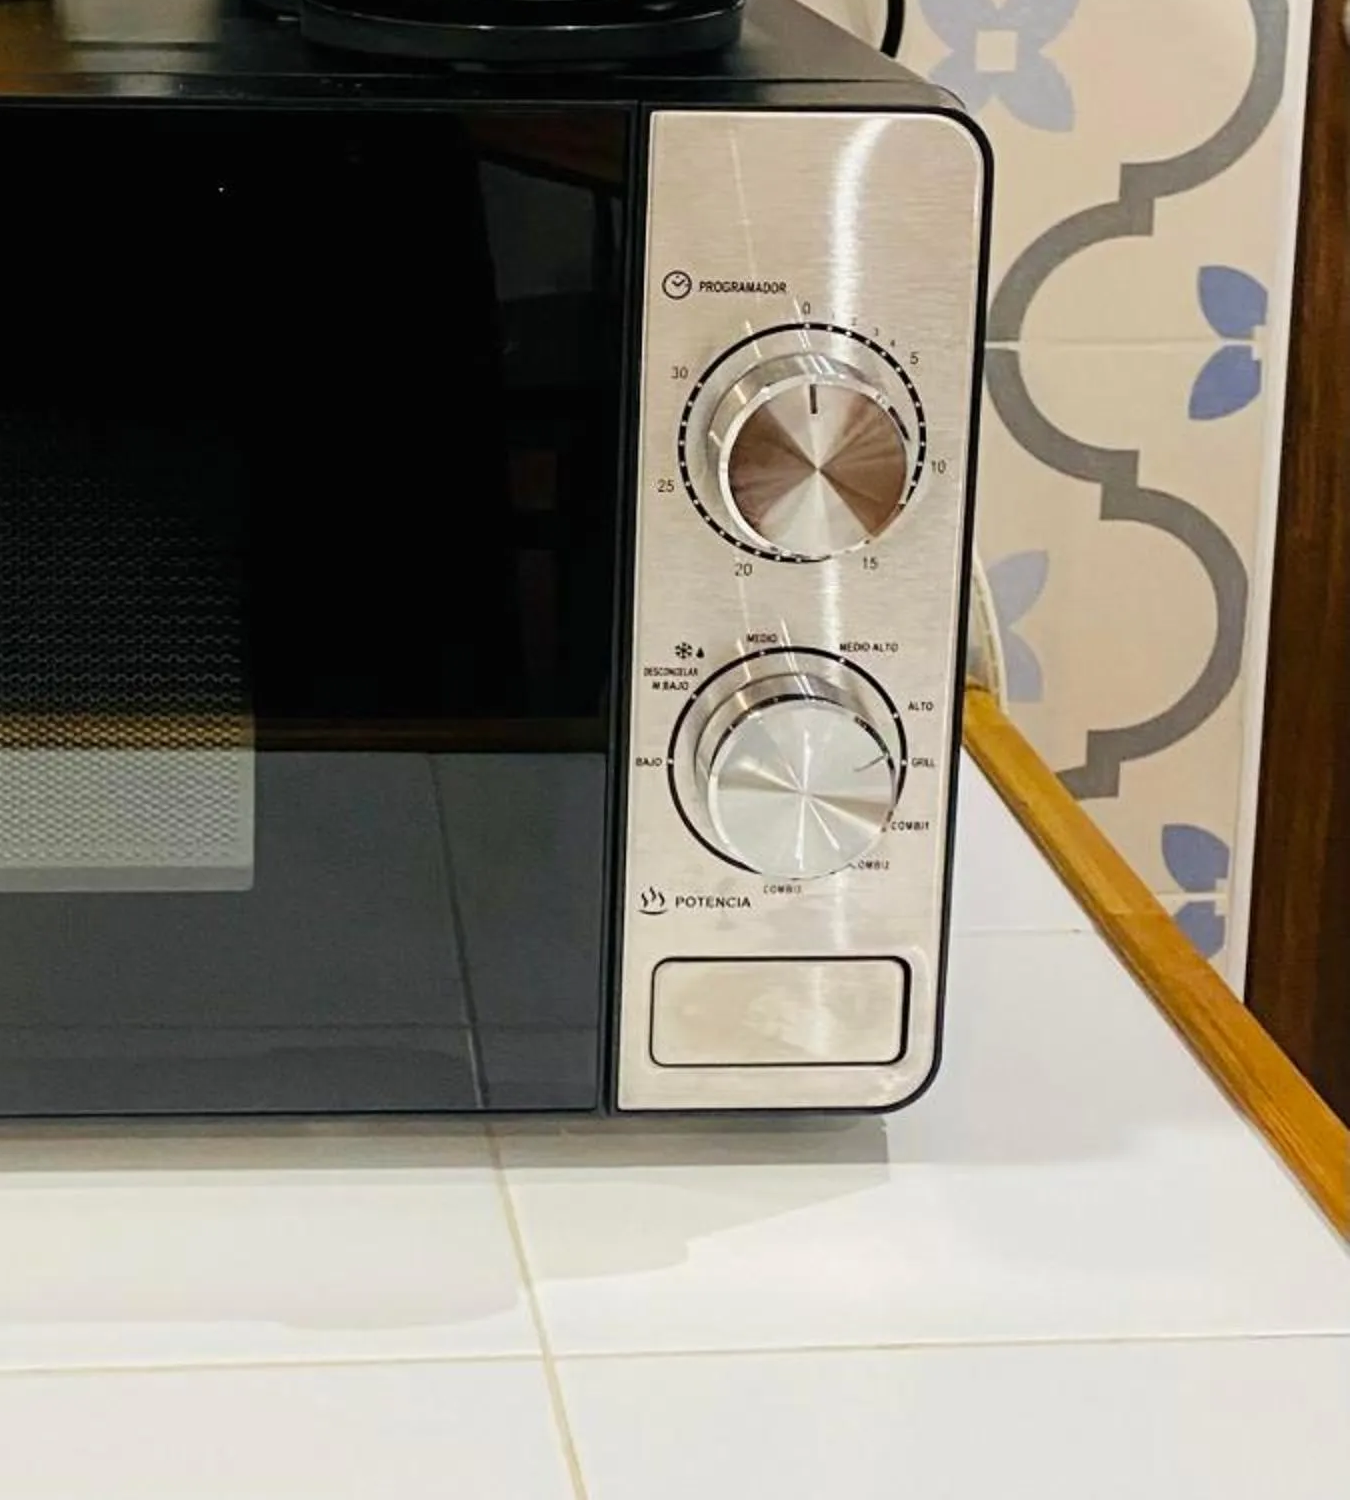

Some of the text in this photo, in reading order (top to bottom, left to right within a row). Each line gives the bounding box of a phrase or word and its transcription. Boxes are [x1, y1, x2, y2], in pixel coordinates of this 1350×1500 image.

[699, 280, 787, 294] PROGRAMADOR
[802, 301, 811, 315] 0
[910, 351, 919, 365] 5
[671, 366, 689, 380] 30
[931, 460, 947, 474] 10
[657, 479, 675, 493] 25
[734, 563, 753, 577] 20
[863, 556, 878, 570] 15
[746, 633, 778, 643] MEDIO
[908, 701, 935, 711] ALTO
[635, 757, 663, 767] BAJO
[911, 758, 936, 768] GRILL
[675, 895, 752, 909] POTENCIA
